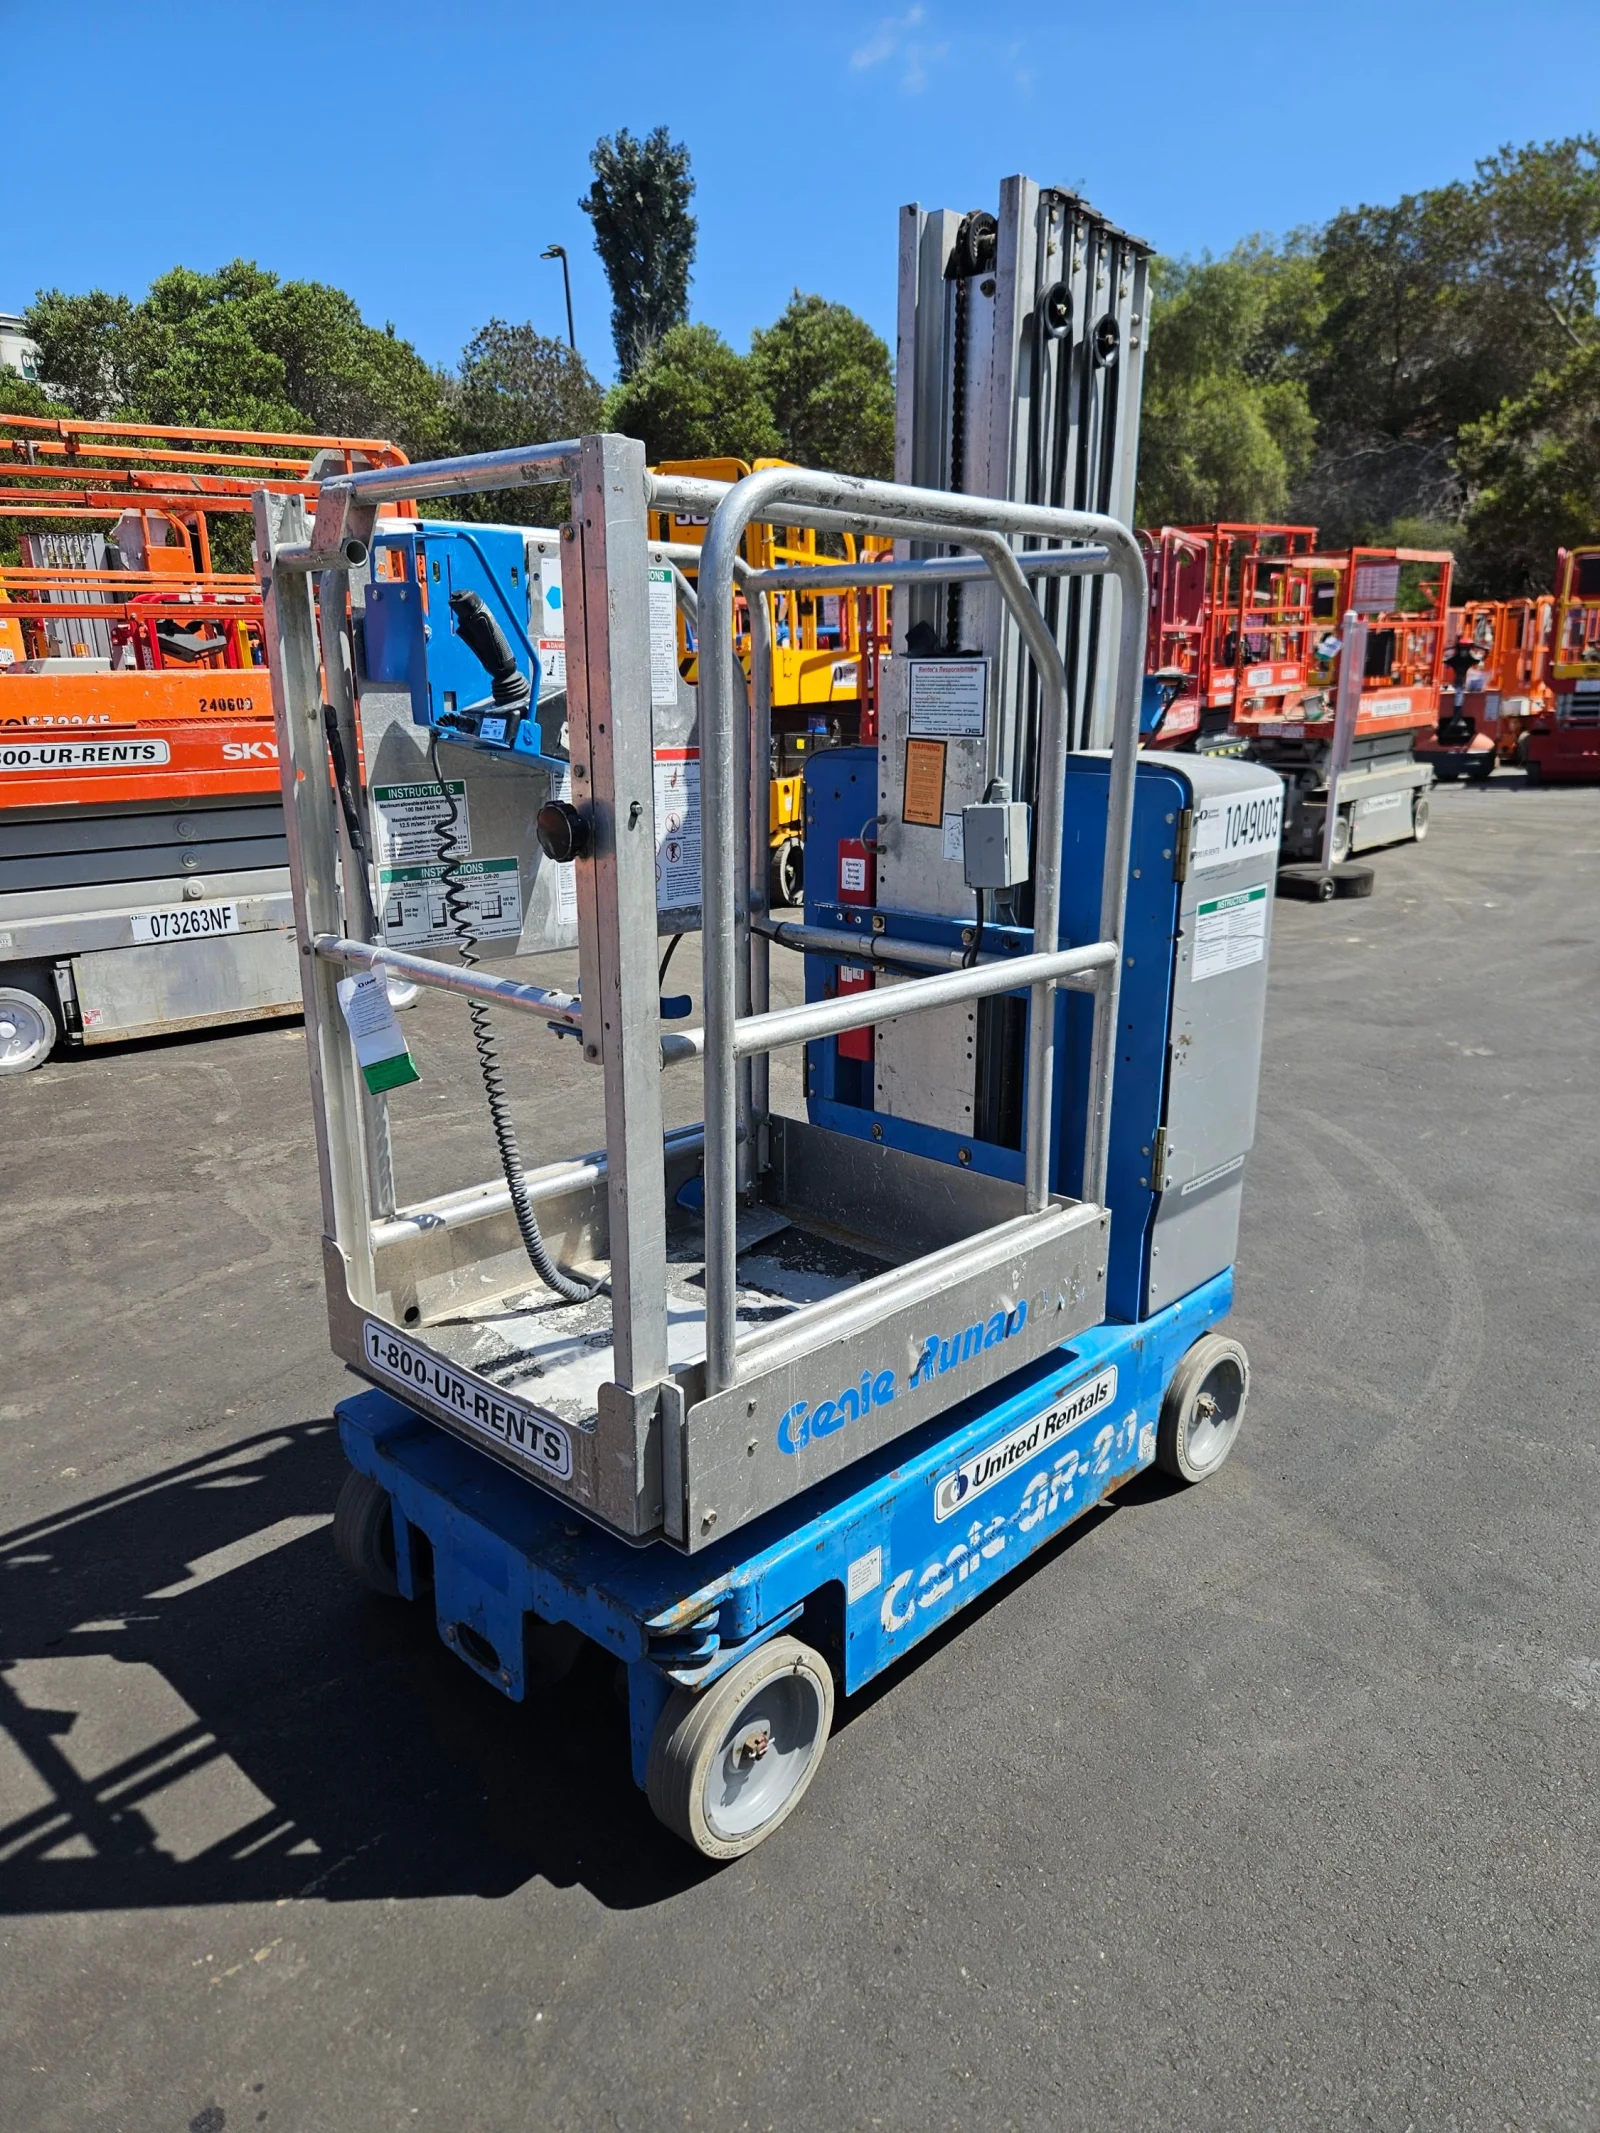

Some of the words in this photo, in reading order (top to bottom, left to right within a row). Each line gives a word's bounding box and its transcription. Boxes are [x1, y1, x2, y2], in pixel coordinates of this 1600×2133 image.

[0, 745, 155, 765] 00-UR-RENTS
[912, 743, 940, 752] WARNING
[388, 784, 454, 799] INSTRUCTIOS
[1225, 796, 1280, 849] 1049005
[421, 863, 484, 878] INSTRCTIONS
[1216, 894, 1250, 910] INSTRUCTIONS
[151, 907, 231, 937] 073263NF
[371, 1334, 561, 1462] 1-800-UR-RENTS
[778, 1369, 895, 1455] Genie
[972, 1422, 1040, 1486] United
[1043, 1382, 1108, 1440] Rentals
